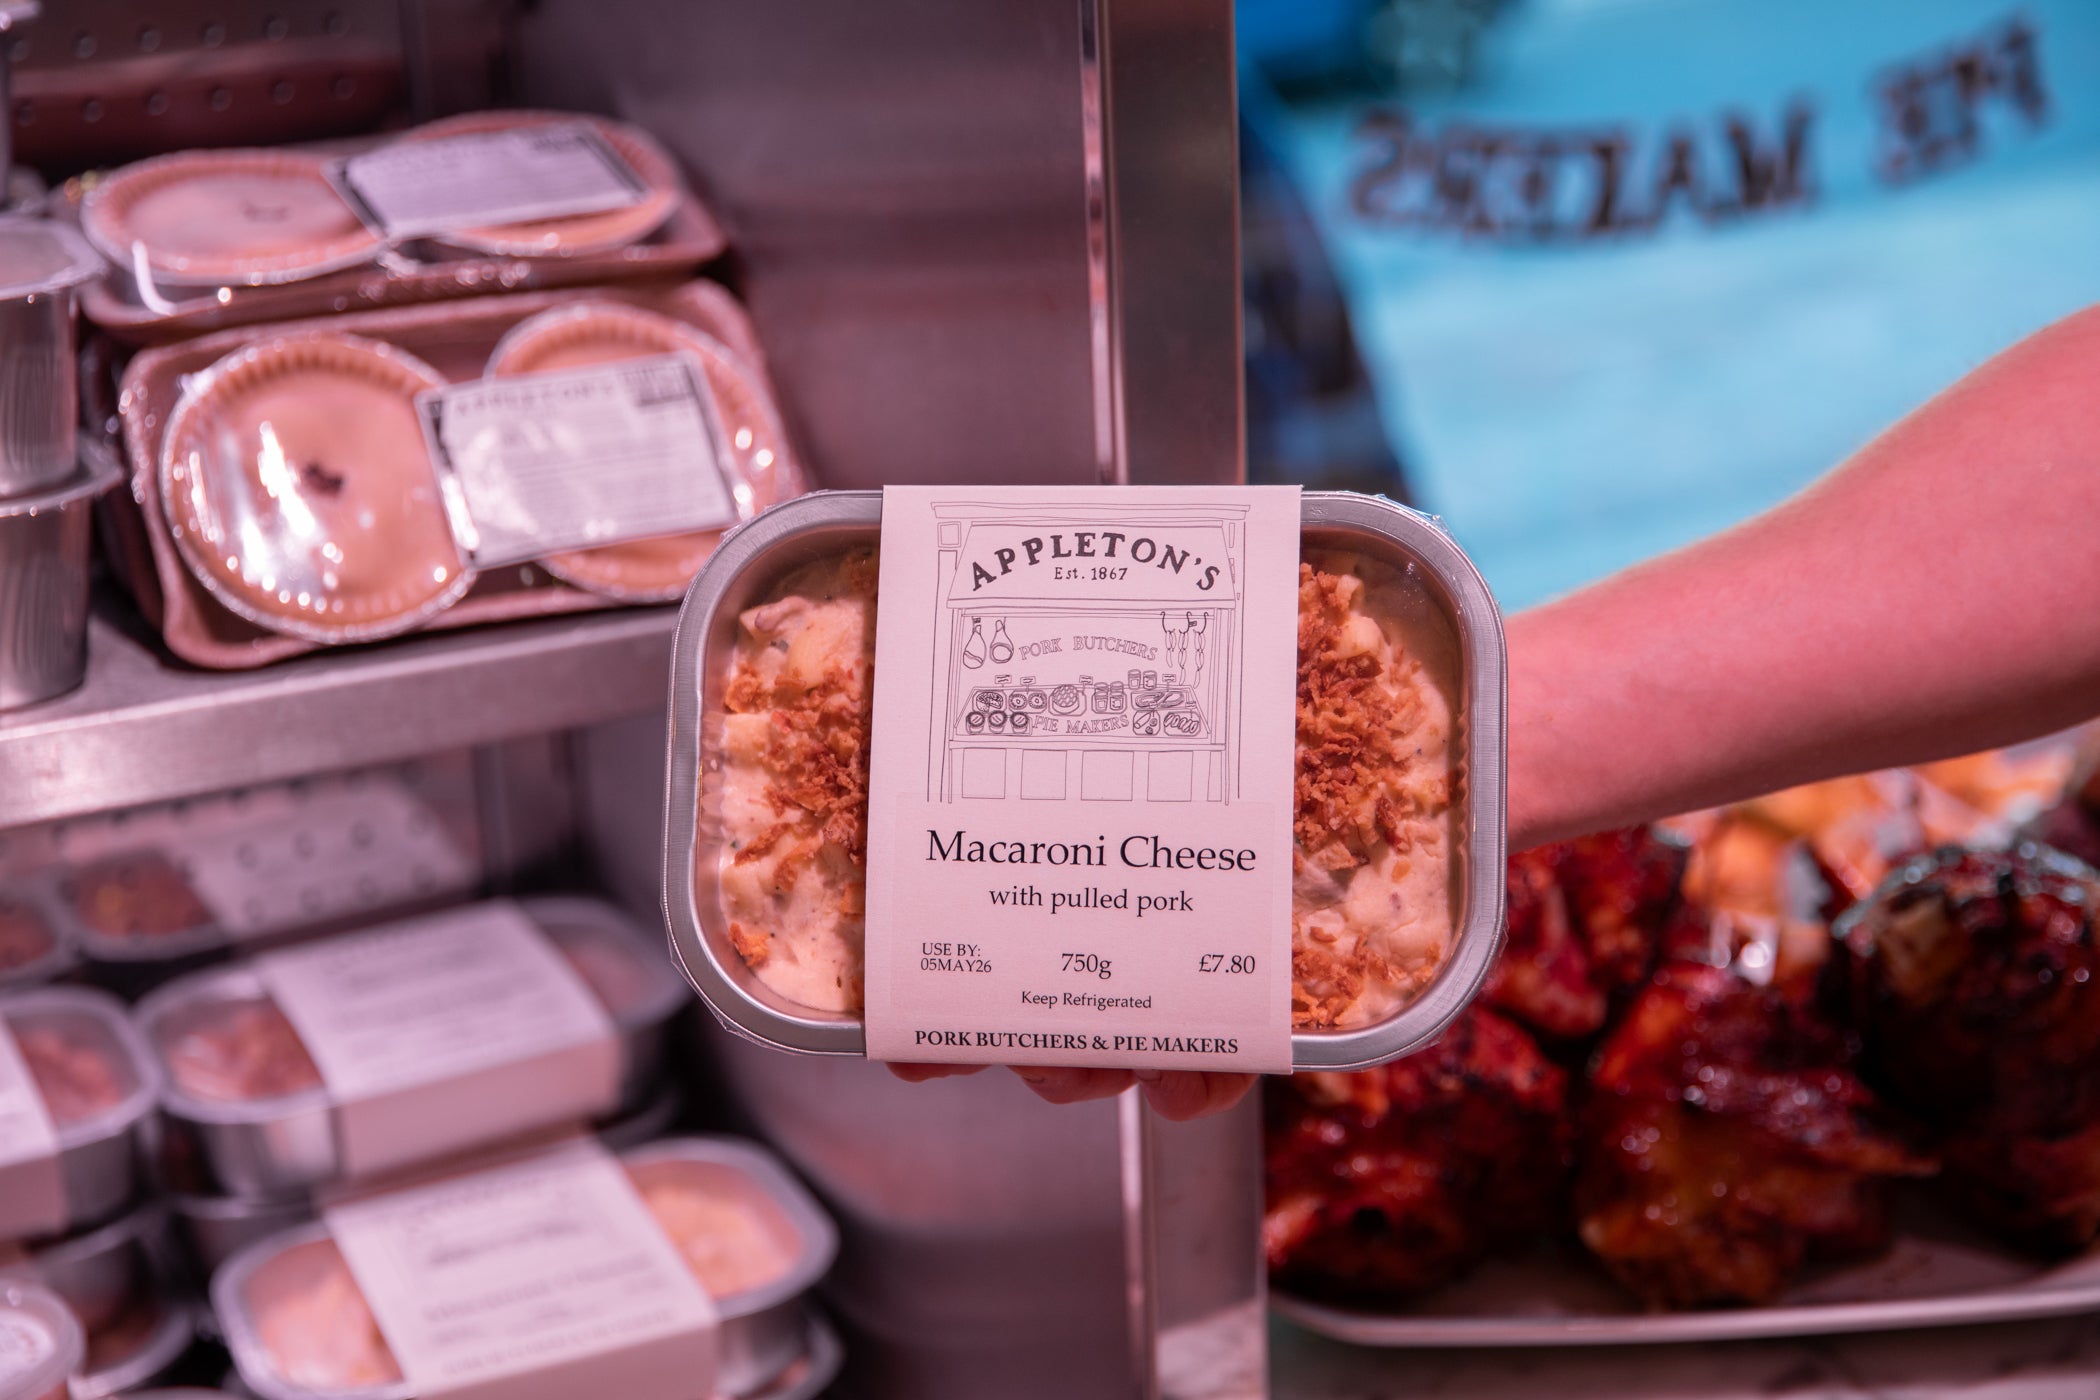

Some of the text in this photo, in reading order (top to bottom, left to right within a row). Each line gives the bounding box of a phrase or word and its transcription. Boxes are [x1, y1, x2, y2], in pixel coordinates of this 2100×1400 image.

[971, 531, 1221, 592] APPLETON'S
[1053, 566, 1129, 581] Est. 1867
[1018, 635, 1159, 662] PORK BUTCHERS
[1032, 714, 1130, 735] PIE MAKERS
[925, 829, 1257, 872] Macaroni Cheese
[988, 884, 1194, 918] with pulled pork
[921, 942, 982, 958] USE BY:
[920, 957, 993, 974] 05MAY26
[1060, 952, 1113, 980] 750g
[1197, 953, 1257, 975] £7.80
[1021, 990, 1153, 1012] Keep Refrigerated
[914, 1030, 1239, 1055] PORK BUTCHERS & PIE MAKERS
